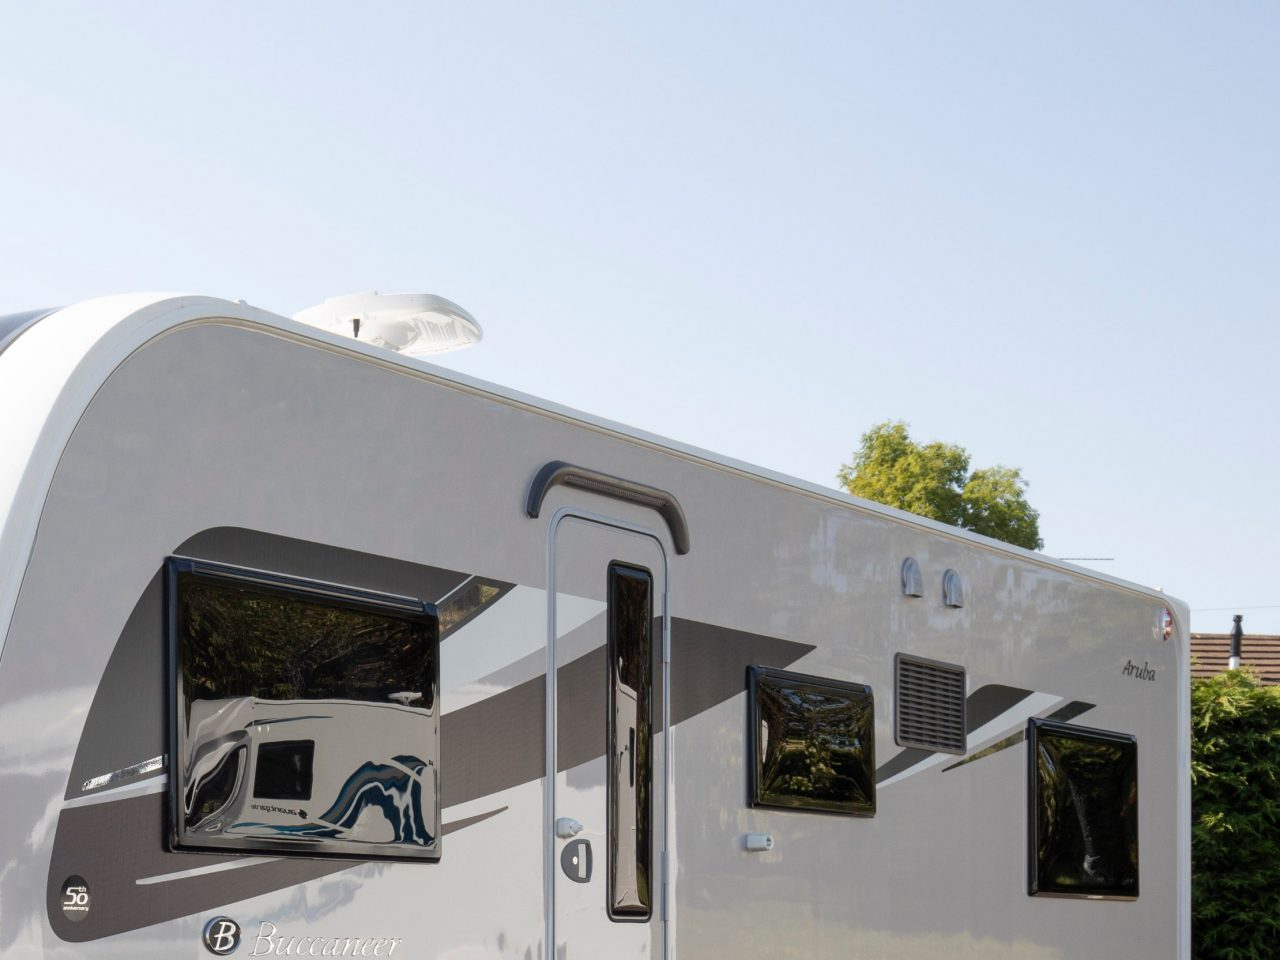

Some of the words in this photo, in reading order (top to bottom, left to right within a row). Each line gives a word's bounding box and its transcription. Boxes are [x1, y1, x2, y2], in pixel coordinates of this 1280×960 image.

[1122, 659, 1156, 682] Aruba
[213, 921, 237, 952] B
[248, 920, 402, 957] Buccaneer
